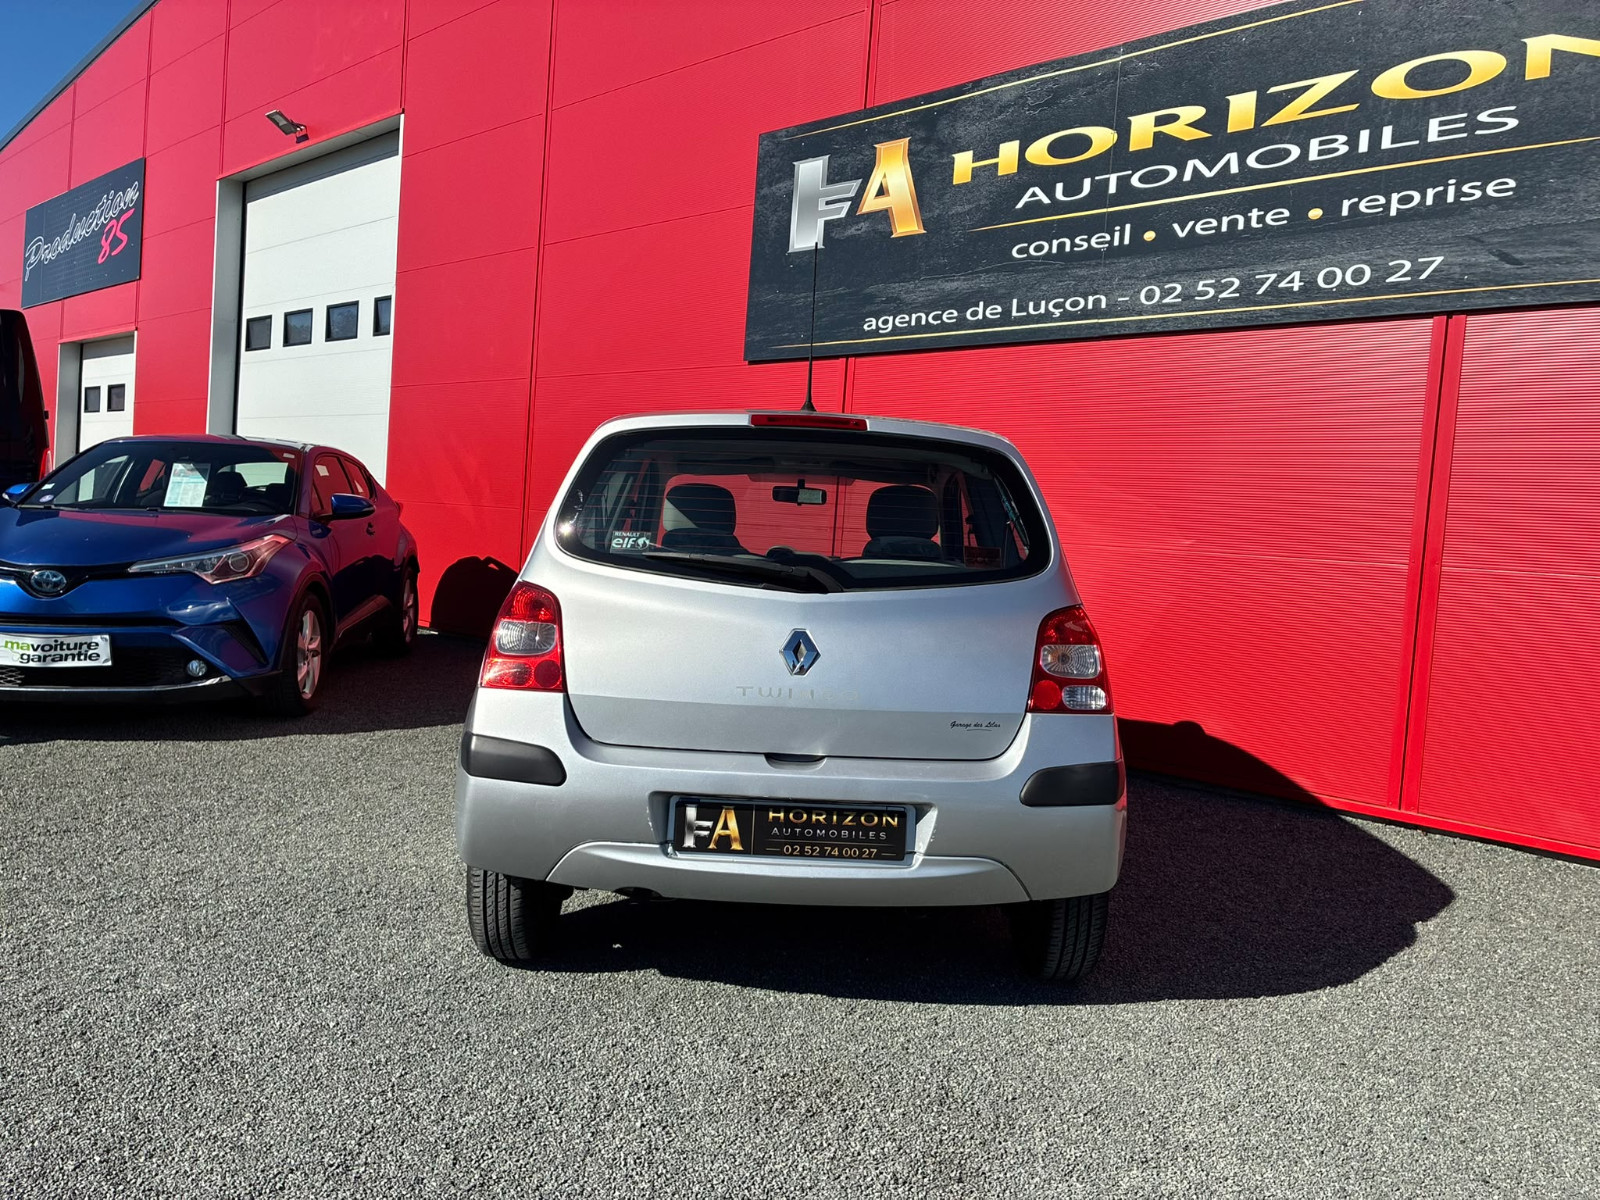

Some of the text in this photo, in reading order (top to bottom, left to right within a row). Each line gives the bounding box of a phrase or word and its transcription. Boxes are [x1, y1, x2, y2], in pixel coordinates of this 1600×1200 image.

[1015, 105, 1520, 210] AUTOMOBILES
[1011, 176, 1518, 259] conseil vente reprise
[25, 180, 140, 282] Production
[97, 207, 136, 265] 85
[862, 308, 958, 334] agence
[965, 301, 1003, 321] de
[1010, 292, 1107, 318] Luçon
[1139, 283, 1183, 305] 02
[1194, 277, 1241, 301] 52
[1254, 270, 1305, 296] 74
[1316, 263, 1372, 289] 00
[1384, 256, 1445, 284] 27
[612, 537, 636, 548] elf
[4, 639, 99, 652] mavoiture
[19, 649, 101, 664] garantie
[735, 685, 859, 701] TWIN
[950, 720, 972, 729] Garage
[767, 807, 899, 828] HORIZON
[770, 826, 887, 840] AUTOMOBILES
[783, 844, 878, 859] 02 52 74 00 27
